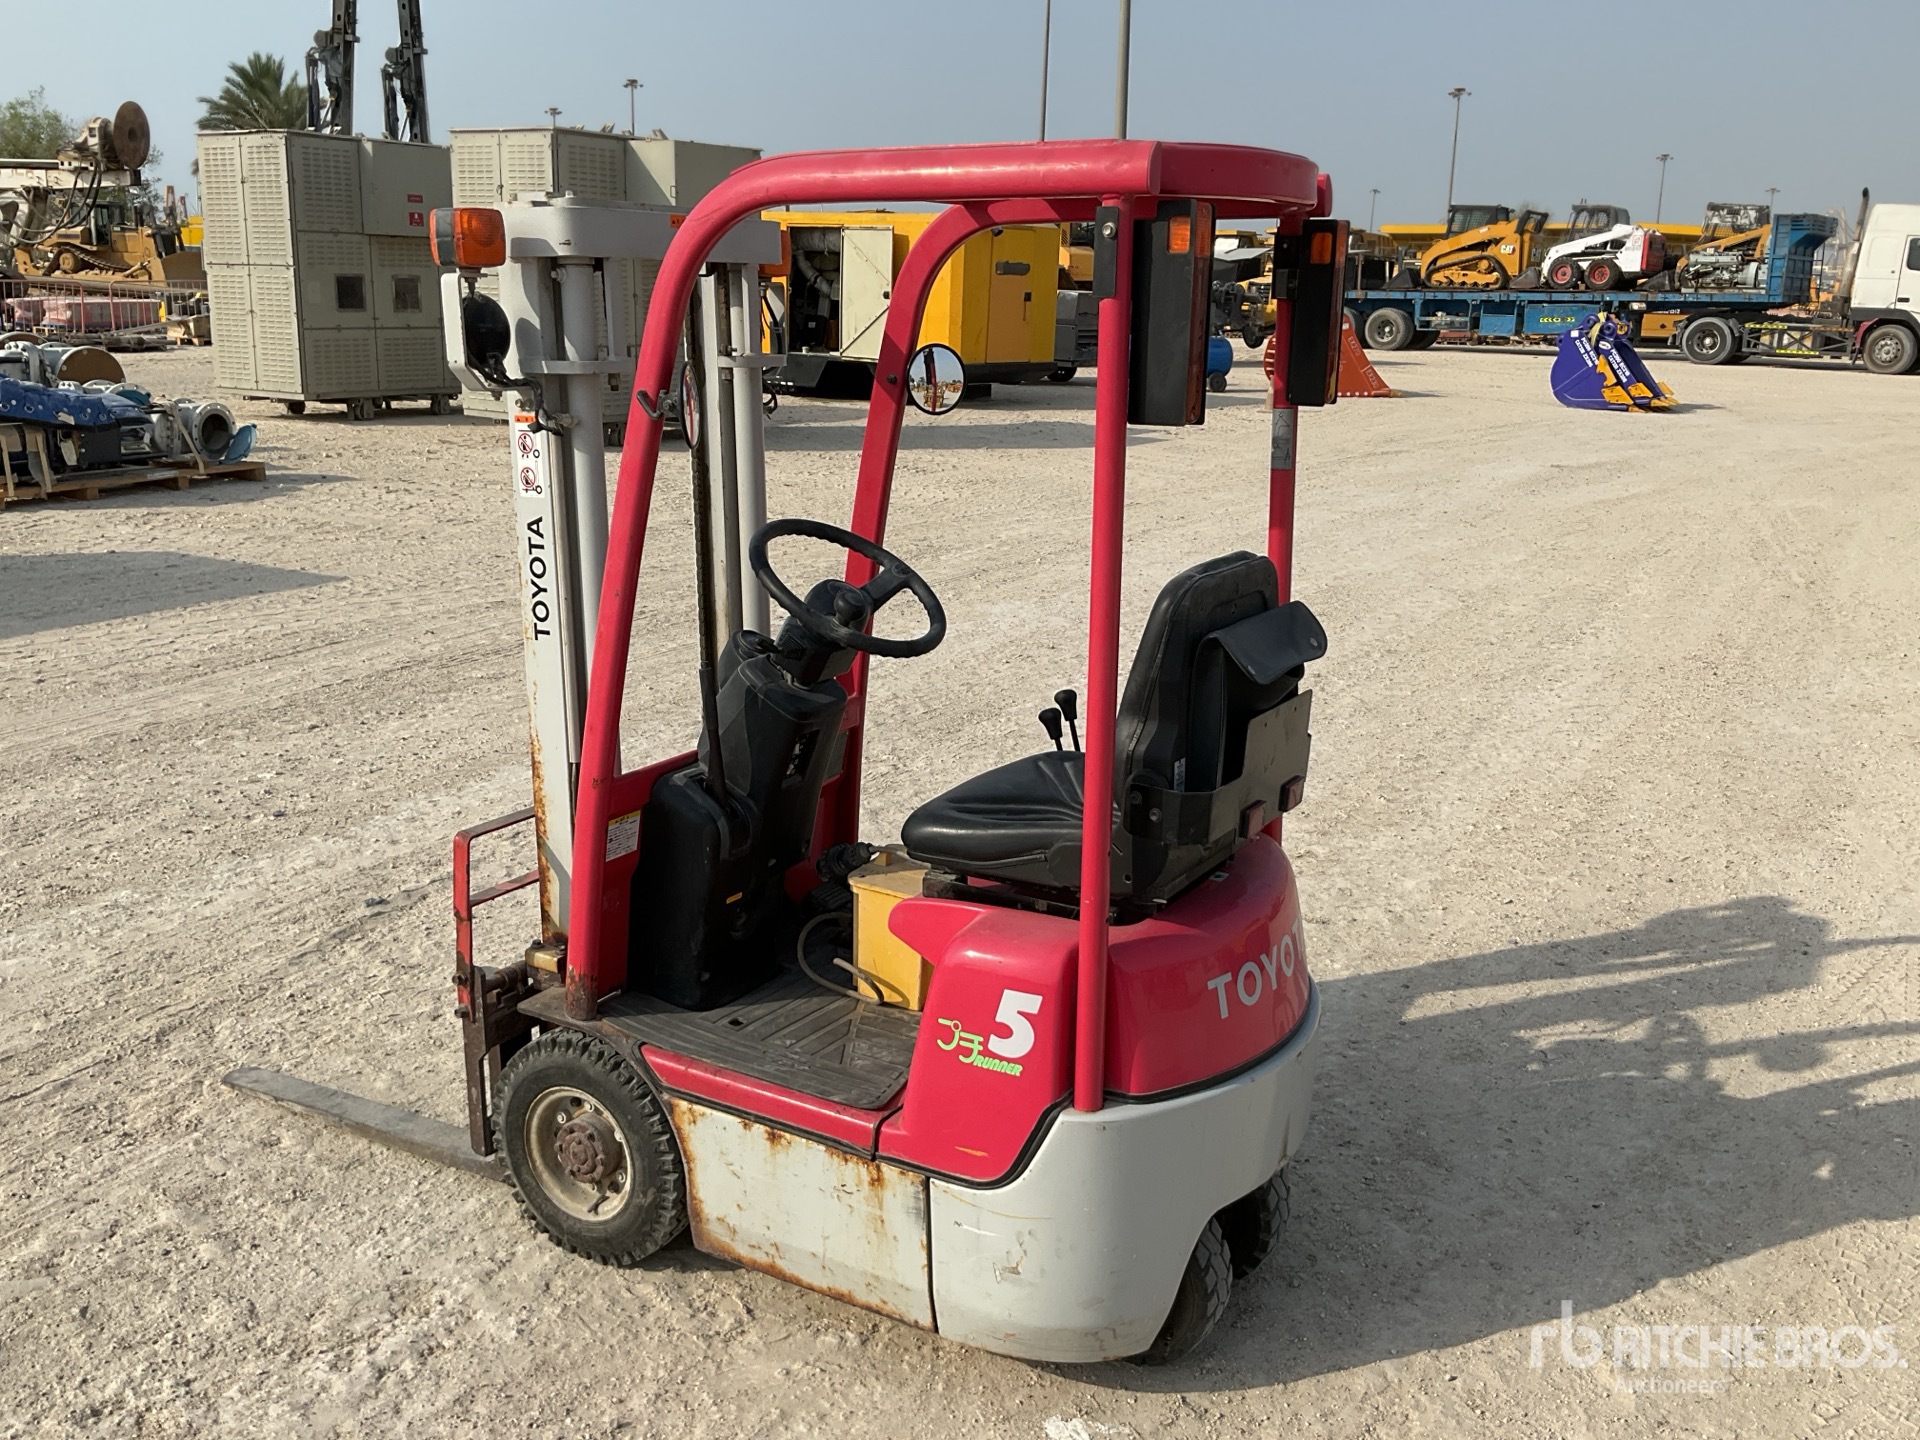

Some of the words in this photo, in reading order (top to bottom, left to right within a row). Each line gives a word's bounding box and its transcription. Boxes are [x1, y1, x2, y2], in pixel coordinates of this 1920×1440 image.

[1501, 245, 1514, 254] CAT
[527, 515, 551, 641] TOYOTA
[1207, 917, 1303, 1019] TOYOT
[988, 988, 1043, 1059] 5
[973, 1054, 1023, 1077] RUNNER
